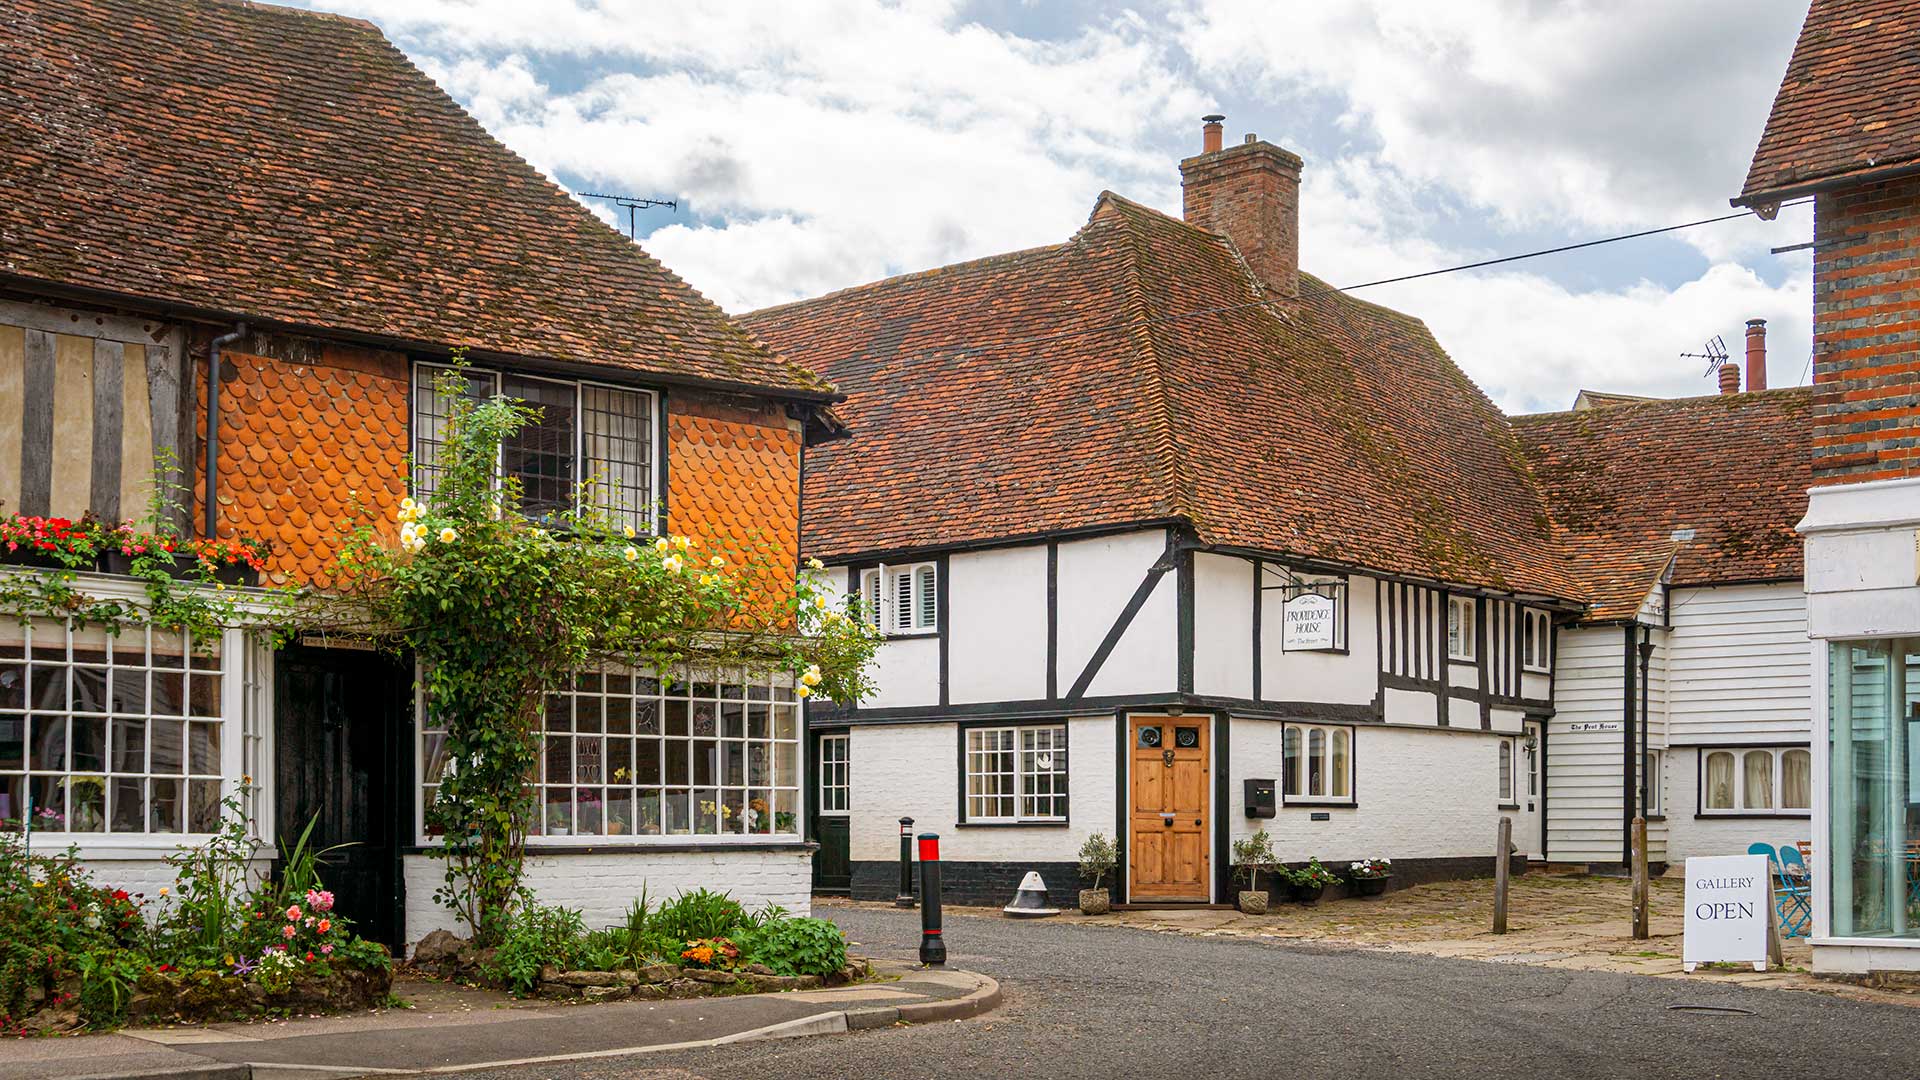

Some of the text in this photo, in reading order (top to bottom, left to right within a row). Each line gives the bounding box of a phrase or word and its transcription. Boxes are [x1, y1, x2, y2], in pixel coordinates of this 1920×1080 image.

[1286, 608, 1331, 622] PROVIDENCE
[1295, 621, 1321, 634] HOUSE
[1696, 877, 1754, 890] GALLERY
[1695, 902, 1754, 920] OPEN
